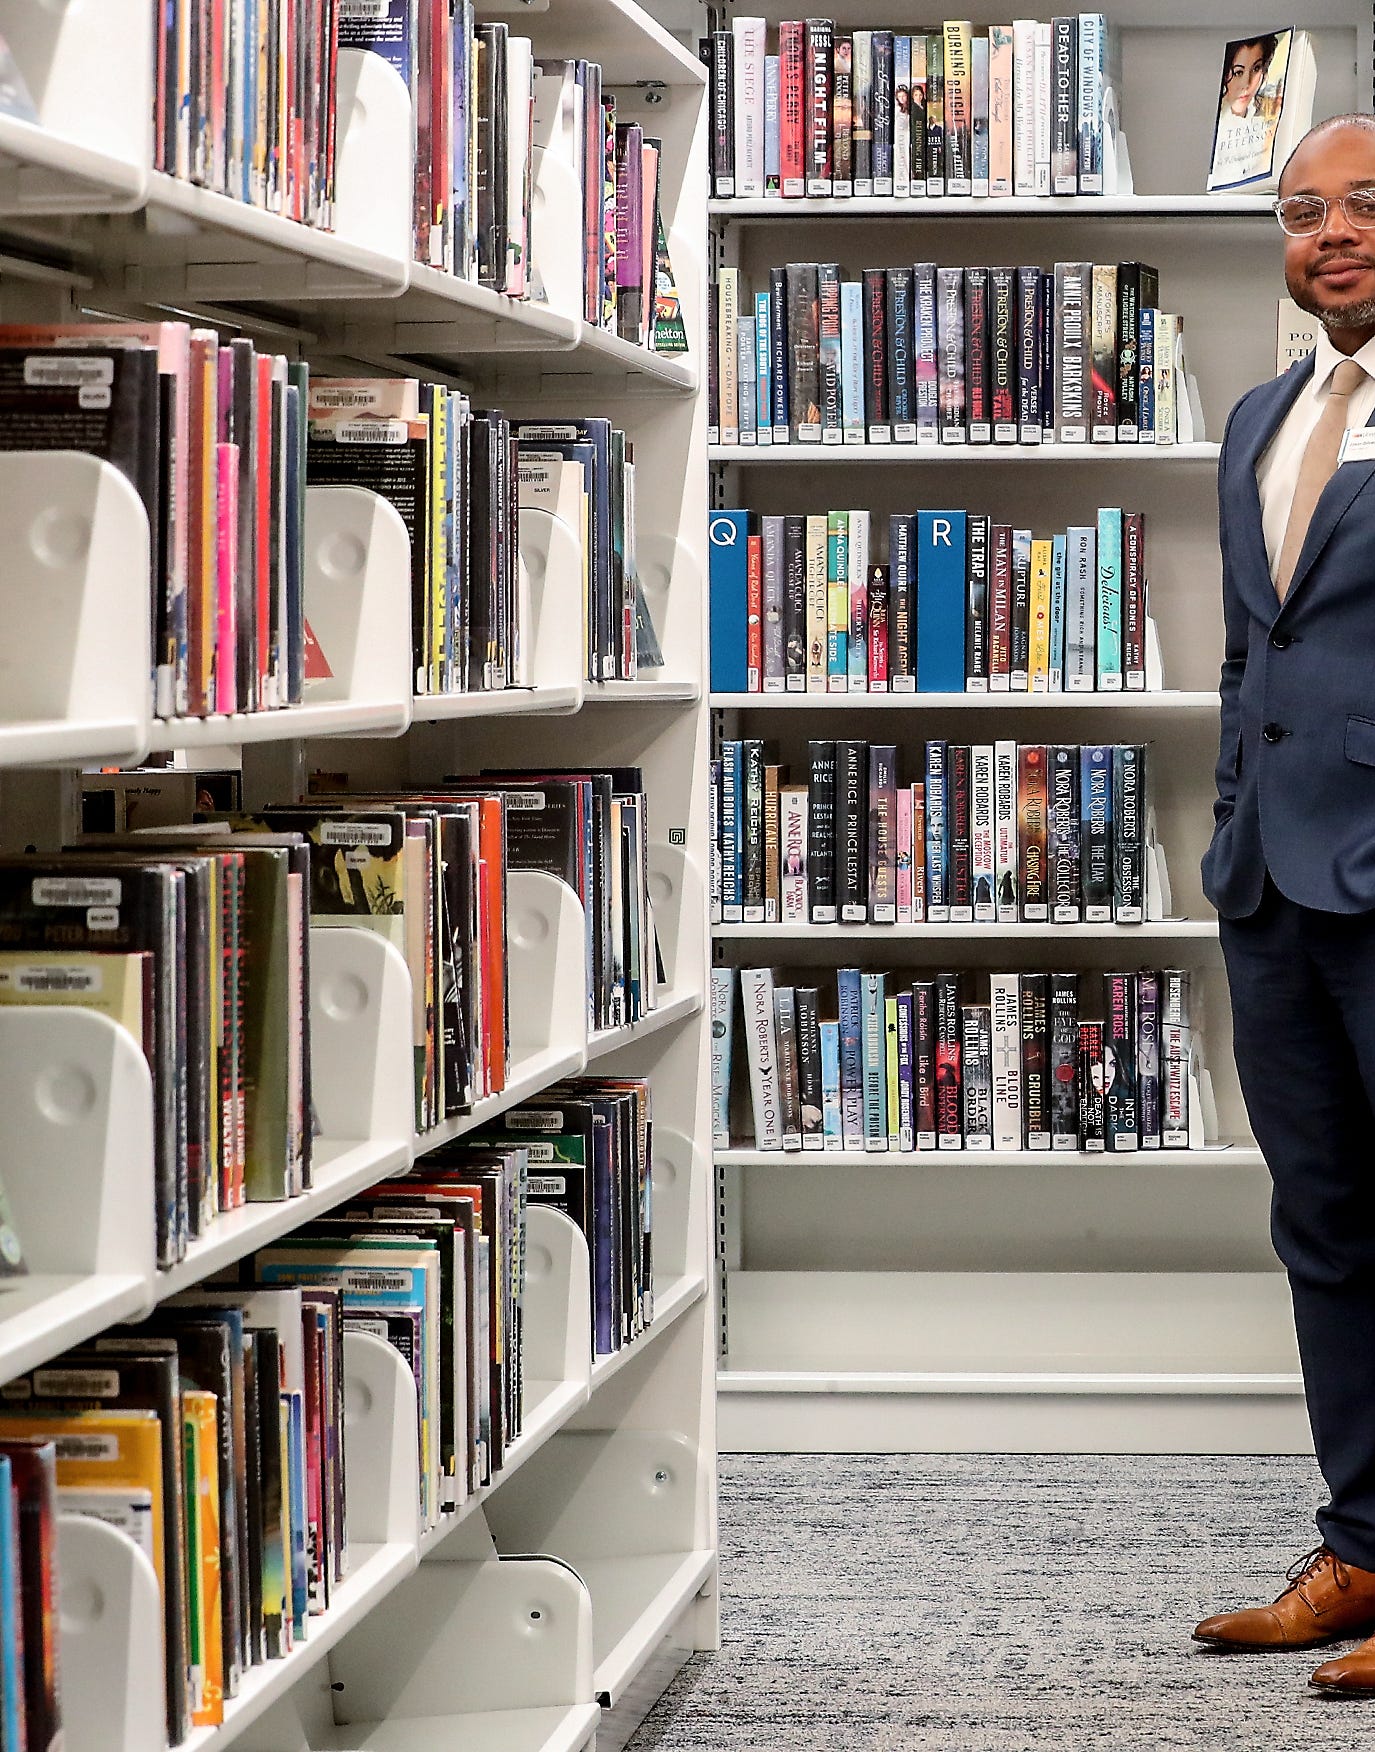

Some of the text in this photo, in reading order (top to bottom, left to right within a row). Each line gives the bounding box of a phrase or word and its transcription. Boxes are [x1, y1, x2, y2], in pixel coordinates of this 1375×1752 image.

[717, 41, 726, 129] CHILDREN OF CHICAGO
[1058, 25, 1069, 123] DEAD TO HER
[1083, 21, 1094, 118] CITY OF WINDOWS
[814, 53, 826, 163] NIGHT FILM
[1063, 276, 1082, 418] ANNIE PROULX BARKSKINS
[710, 519, 736, 546] Q
[932, 520, 952, 546] R
[972, 521, 985, 544] THE
[972, 547, 985, 578] TRAP
[996, 548, 1006, 577] MAN
[1017, 554, 1026, 607] RUPTURE
[995, 589, 1005, 632] MILAN
[1130, 591, 1136, 601] OF
[812, 761, 833, 770] ANNE
[814, 774, 833, 783] RICE
[976, 755, 989, 826] KAREN ROBARDS
[724, 747, 734, 901] FLASH AND BONES KATHY REICHS
[848, 748, 857, 889] ANNE RICE PRINCE LESTAT
[1089, 769, 1106, 882] NORA ROBERTS THE LIAR
[983, 839, 992, 870] MOSCOW
[995, 988, 1006, 1032] ROLLINS
[1006, 993, 1017, 1026] JAMES
[1112, 979, 1123, 1039] KAREN ROSE
[754, 983, 774, 1135] NORA ROBERTS YEAR ONE
[919, 1055, 928, 1074] Like
[1169, 1030, 1180, 1119] THE AUSCHWITZ ESCAPE
[920, 1087, 929, 1107] Bird
[996, 1076, 1006, 1103] LINE
[1007, 1071, 1018, 1109] BLOOD
[1029, 1074, 1041, 1131] CRUCIBLE
